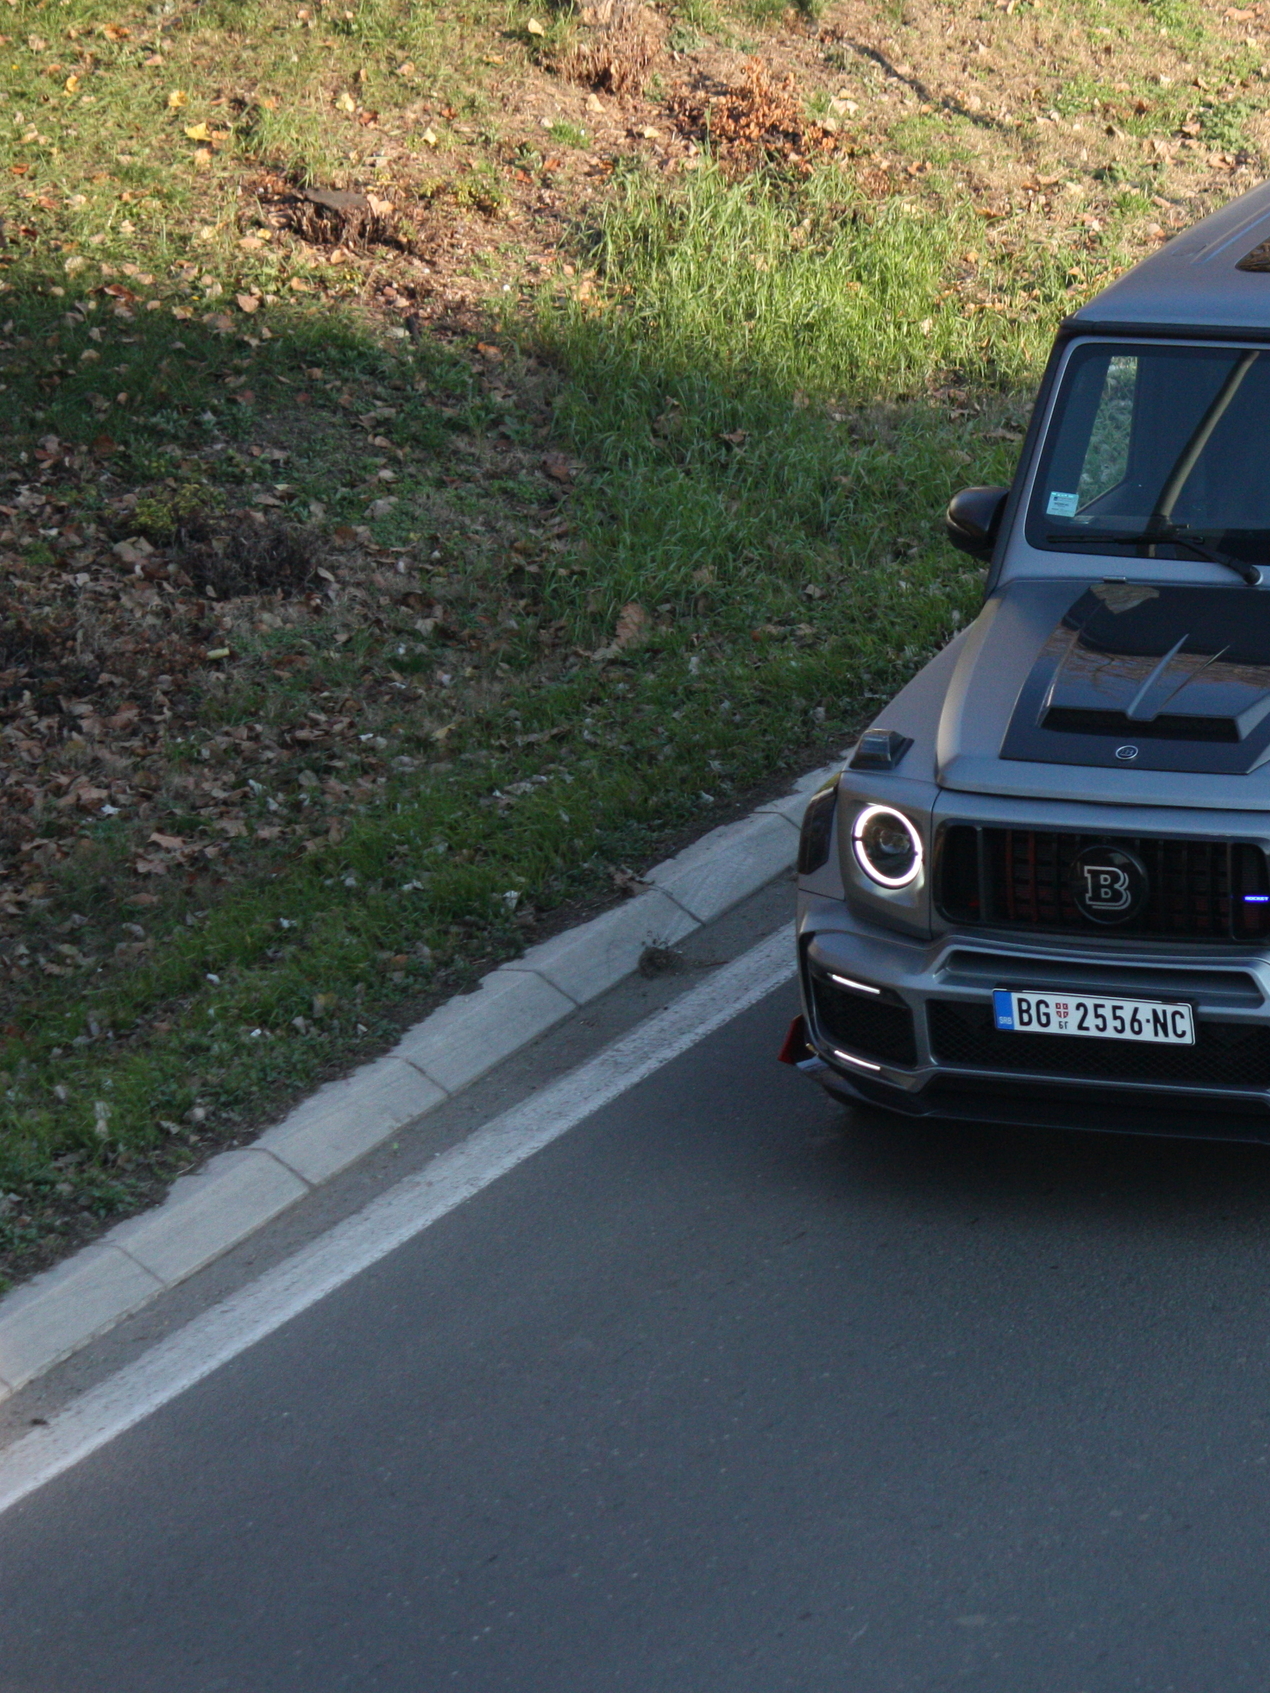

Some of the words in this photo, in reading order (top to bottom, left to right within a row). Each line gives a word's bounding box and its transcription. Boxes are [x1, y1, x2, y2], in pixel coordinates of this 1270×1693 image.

[1084, 865, 1131, 910] B
[998, 1016, 1013, 1025] SRB
[1017, 997, 1051, 1028] BG
